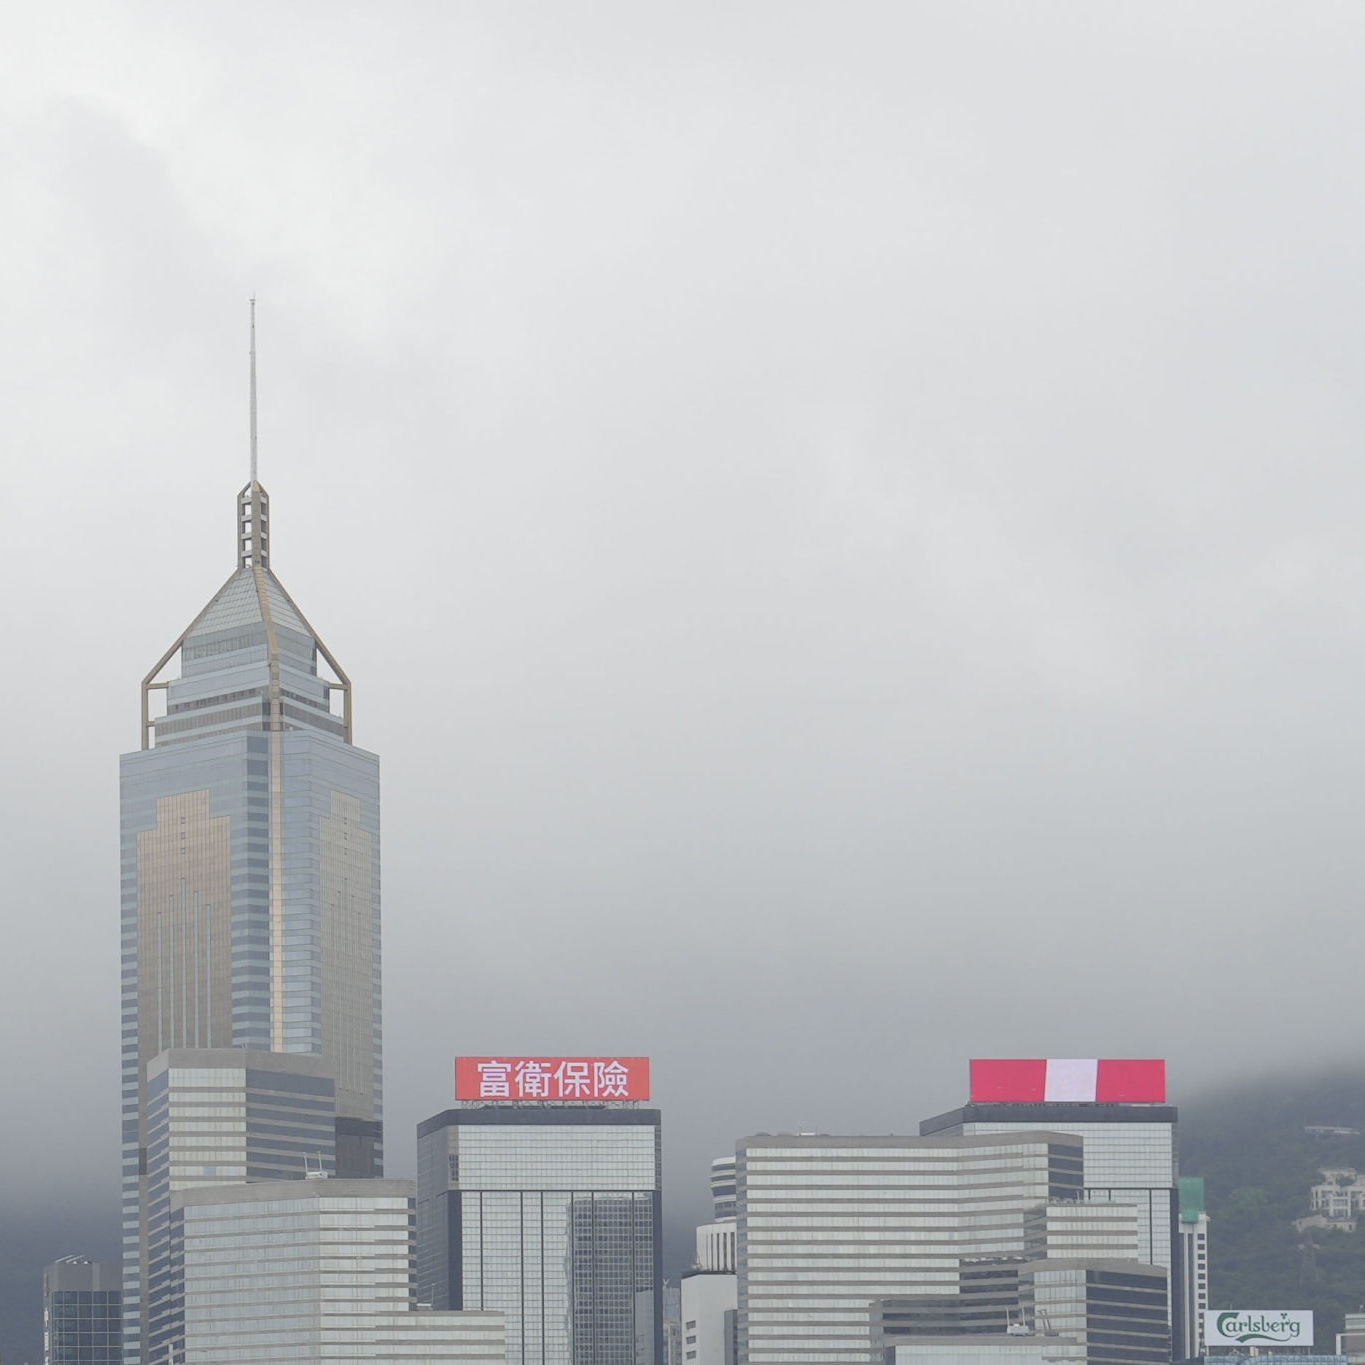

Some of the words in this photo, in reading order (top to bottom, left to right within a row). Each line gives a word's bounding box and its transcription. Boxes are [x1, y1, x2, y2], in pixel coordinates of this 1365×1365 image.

[477, 1060, 629, 1098] 富衛保險
[1216, 1312, 1301, 1338] Carlsberg
